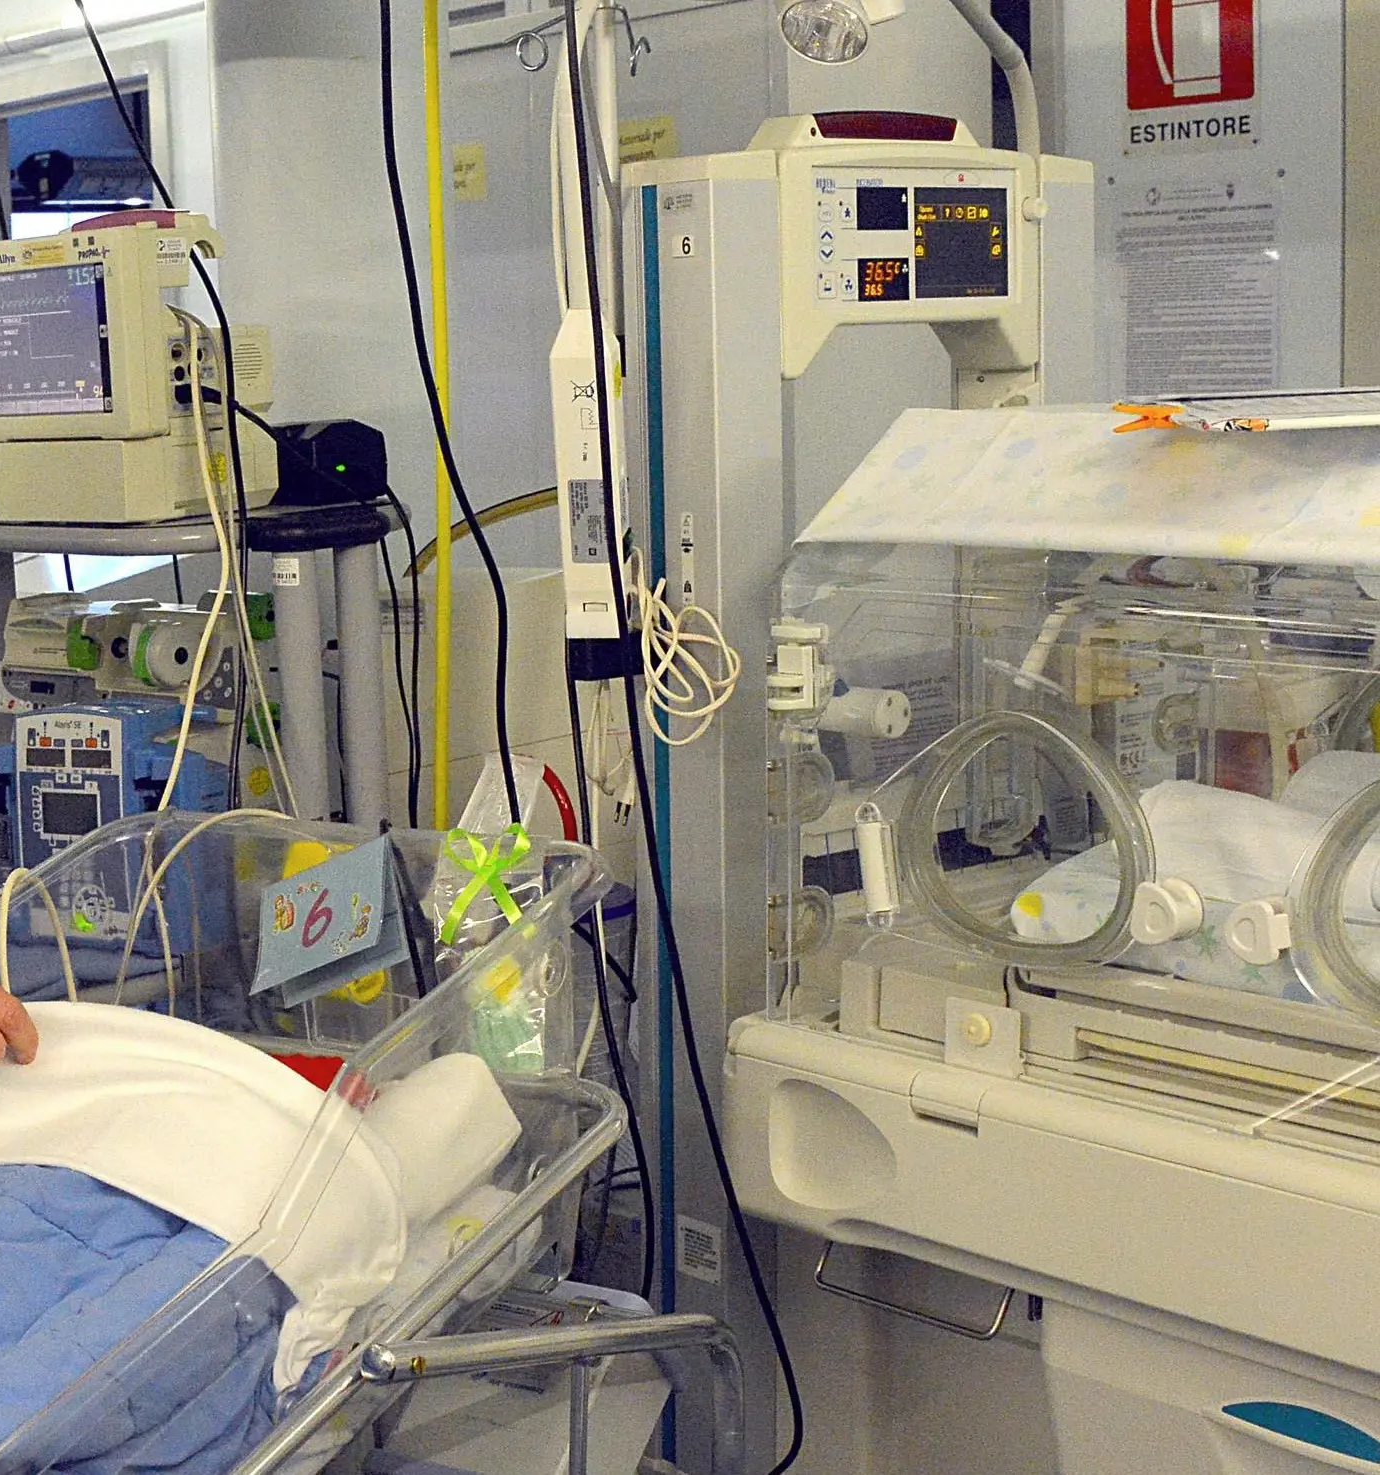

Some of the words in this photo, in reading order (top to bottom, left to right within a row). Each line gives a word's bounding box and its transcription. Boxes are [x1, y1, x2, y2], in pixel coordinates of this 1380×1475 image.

[1130, 115, 1251, 144] ESTINTORE
[681, 236, 691, 255] 6
[301, 888, 333, 948] 6
